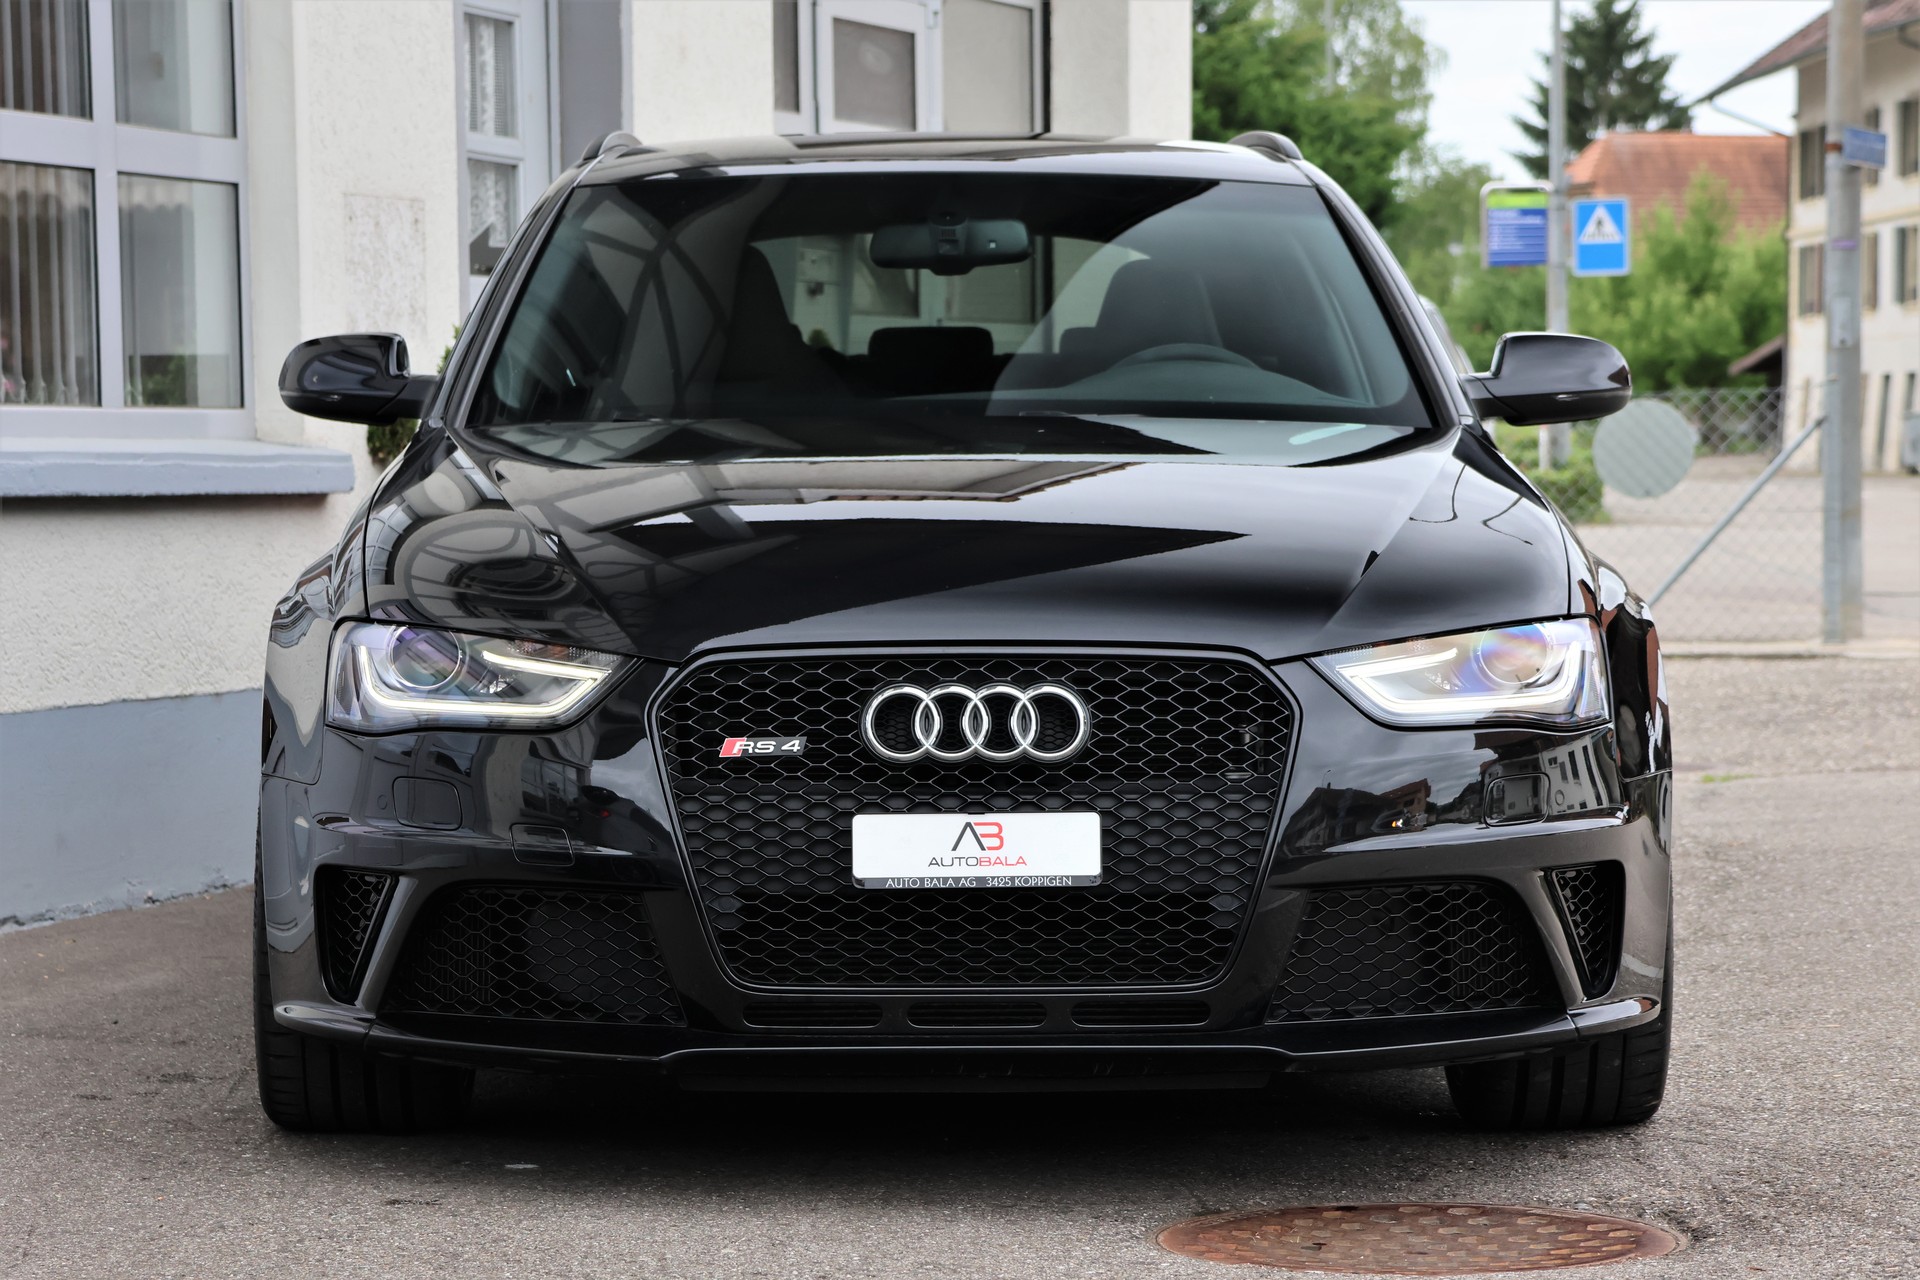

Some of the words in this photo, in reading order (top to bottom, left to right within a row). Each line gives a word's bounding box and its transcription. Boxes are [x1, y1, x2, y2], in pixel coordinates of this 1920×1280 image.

[732, 740, 776, 754] RS
[781, 740, 801, 753] 4
[928, 855, 1027, 868] AUTOBALA
[885, 877, 920, 888] AUTO
[924, 877, 957, 888] BALA
[958, 877, 976, 888] AG
[986, 876, 1012, 887] 3425
[1014, 876, 1072, 887] KOPPIGEN
